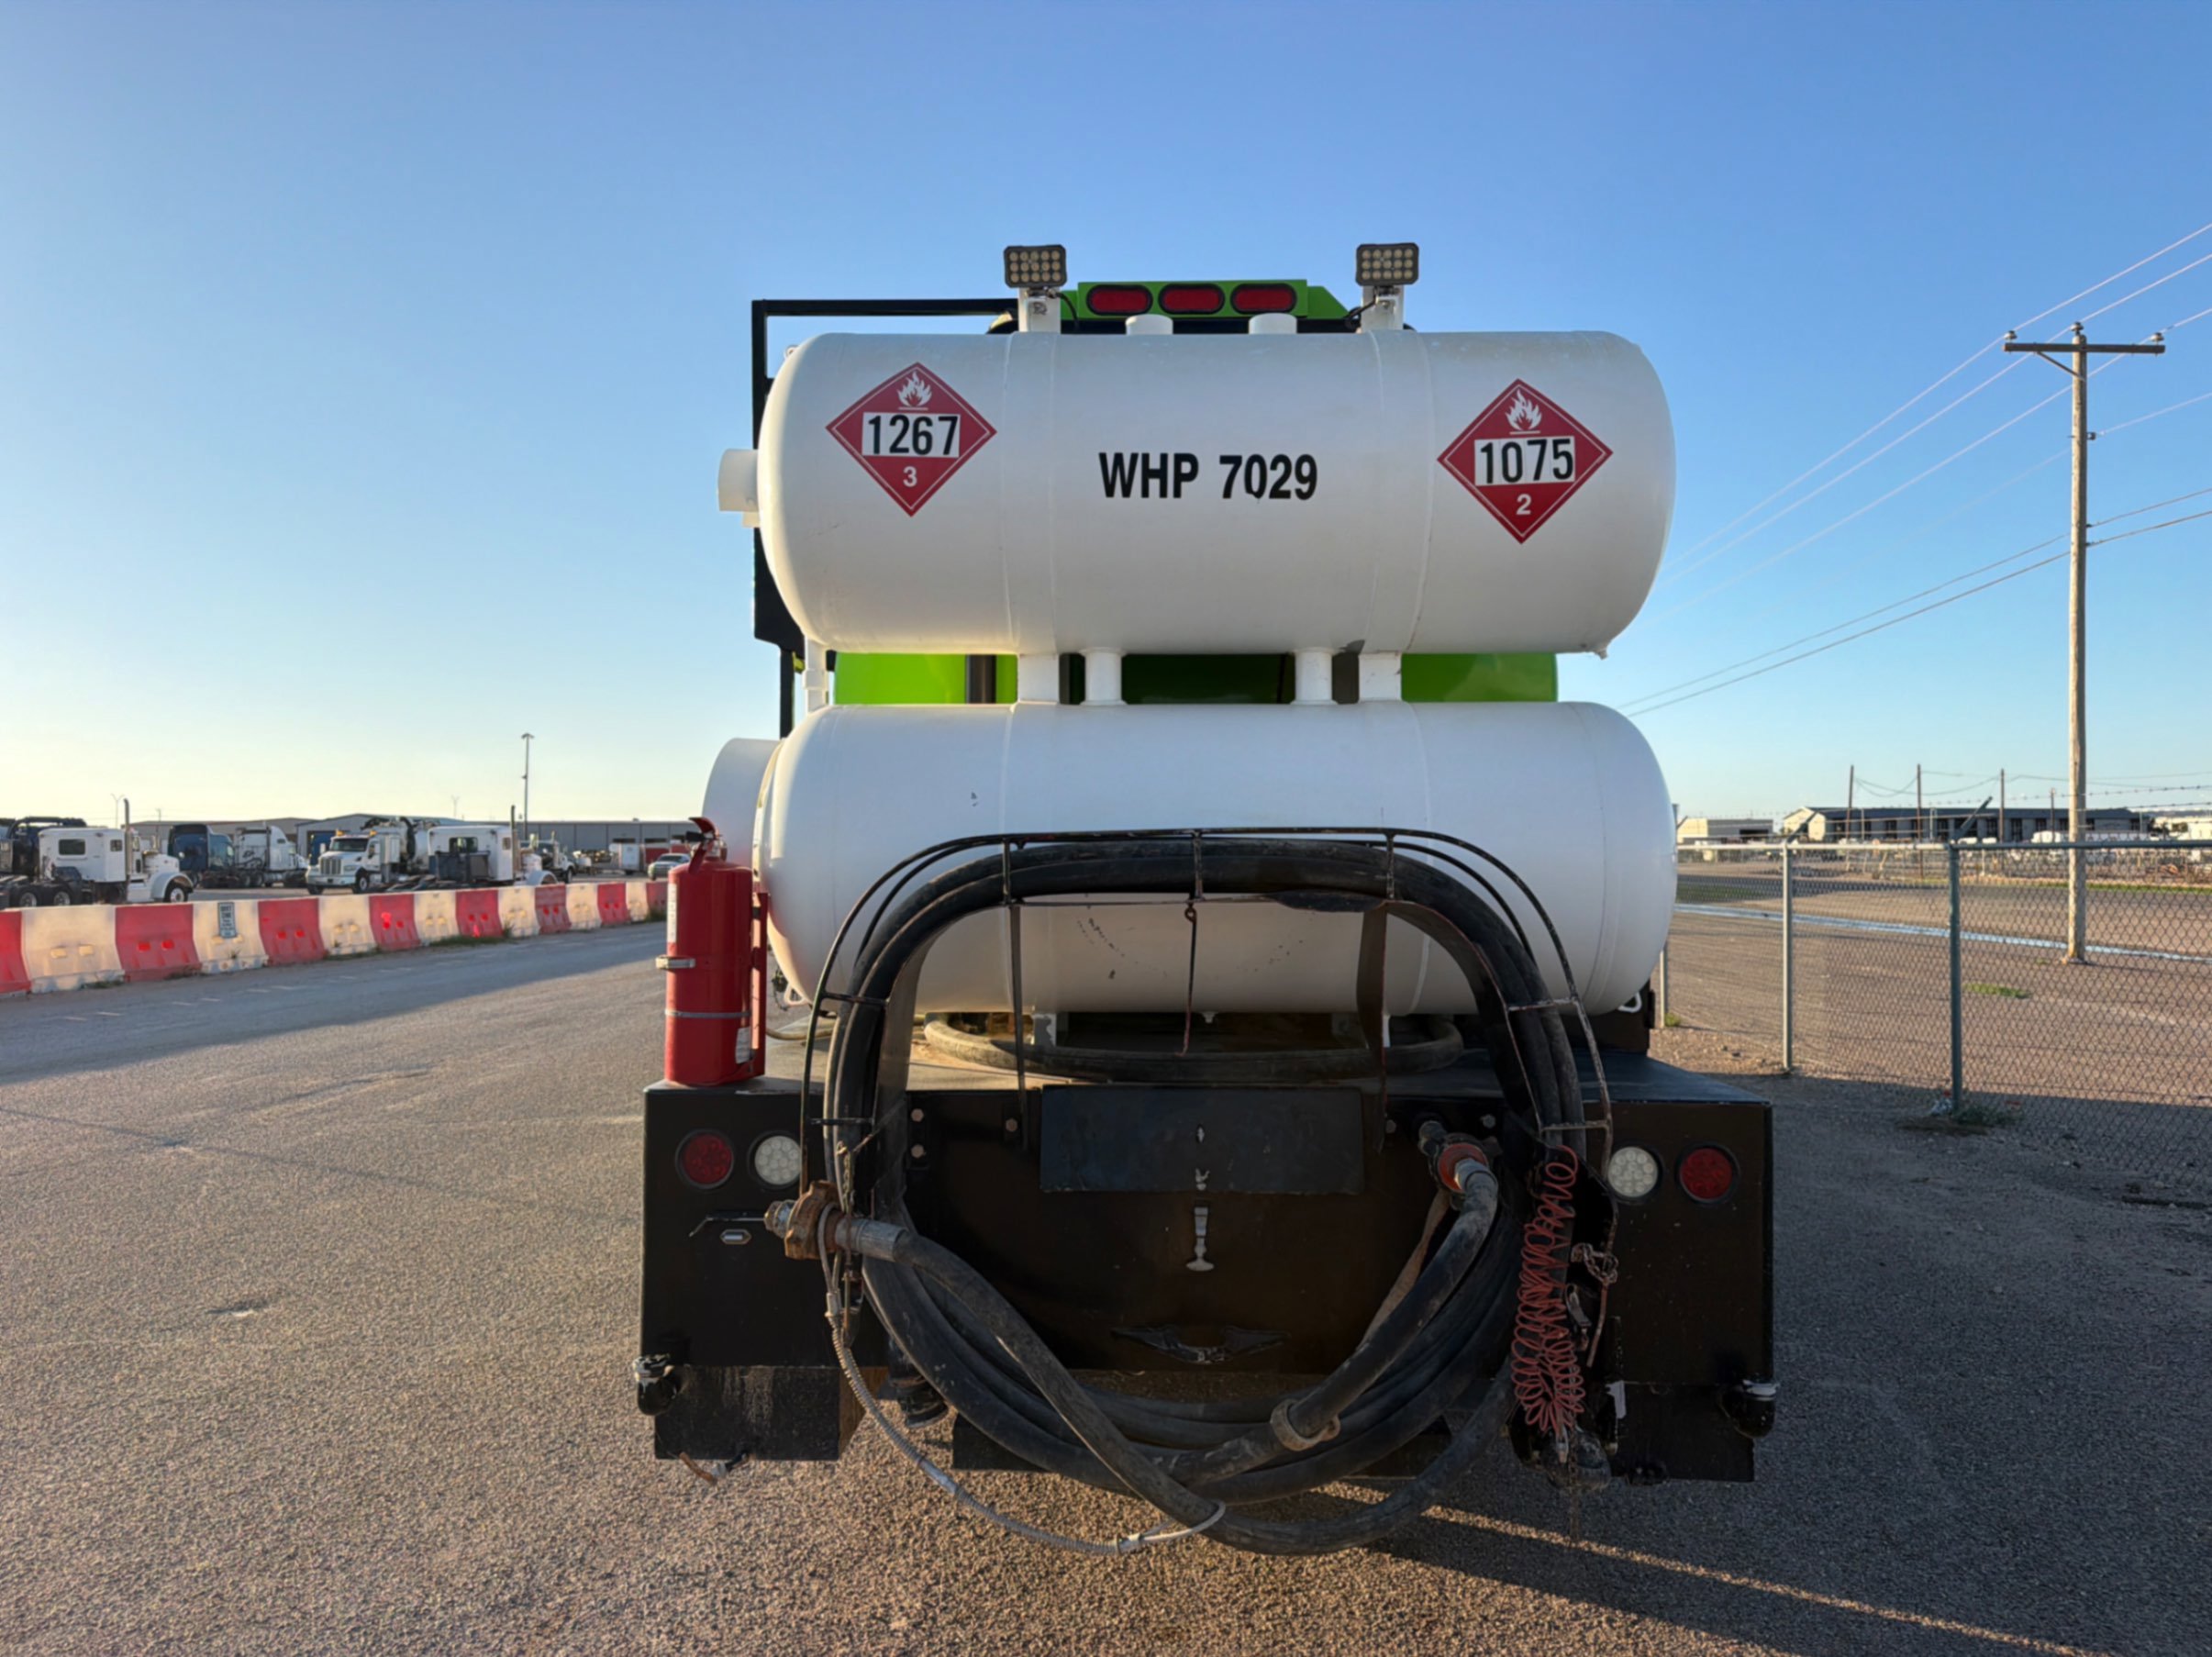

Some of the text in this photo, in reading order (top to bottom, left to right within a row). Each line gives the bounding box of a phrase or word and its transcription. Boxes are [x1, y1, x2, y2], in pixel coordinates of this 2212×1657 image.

[868, 414, 959, 456] 1267
[903, 465, 917, 488] 3
[1099, 452, 1318, 501] WHP 7029
[1480, 438, 1573, 484] 1075
[1516, 493, 1532, 516] 2
